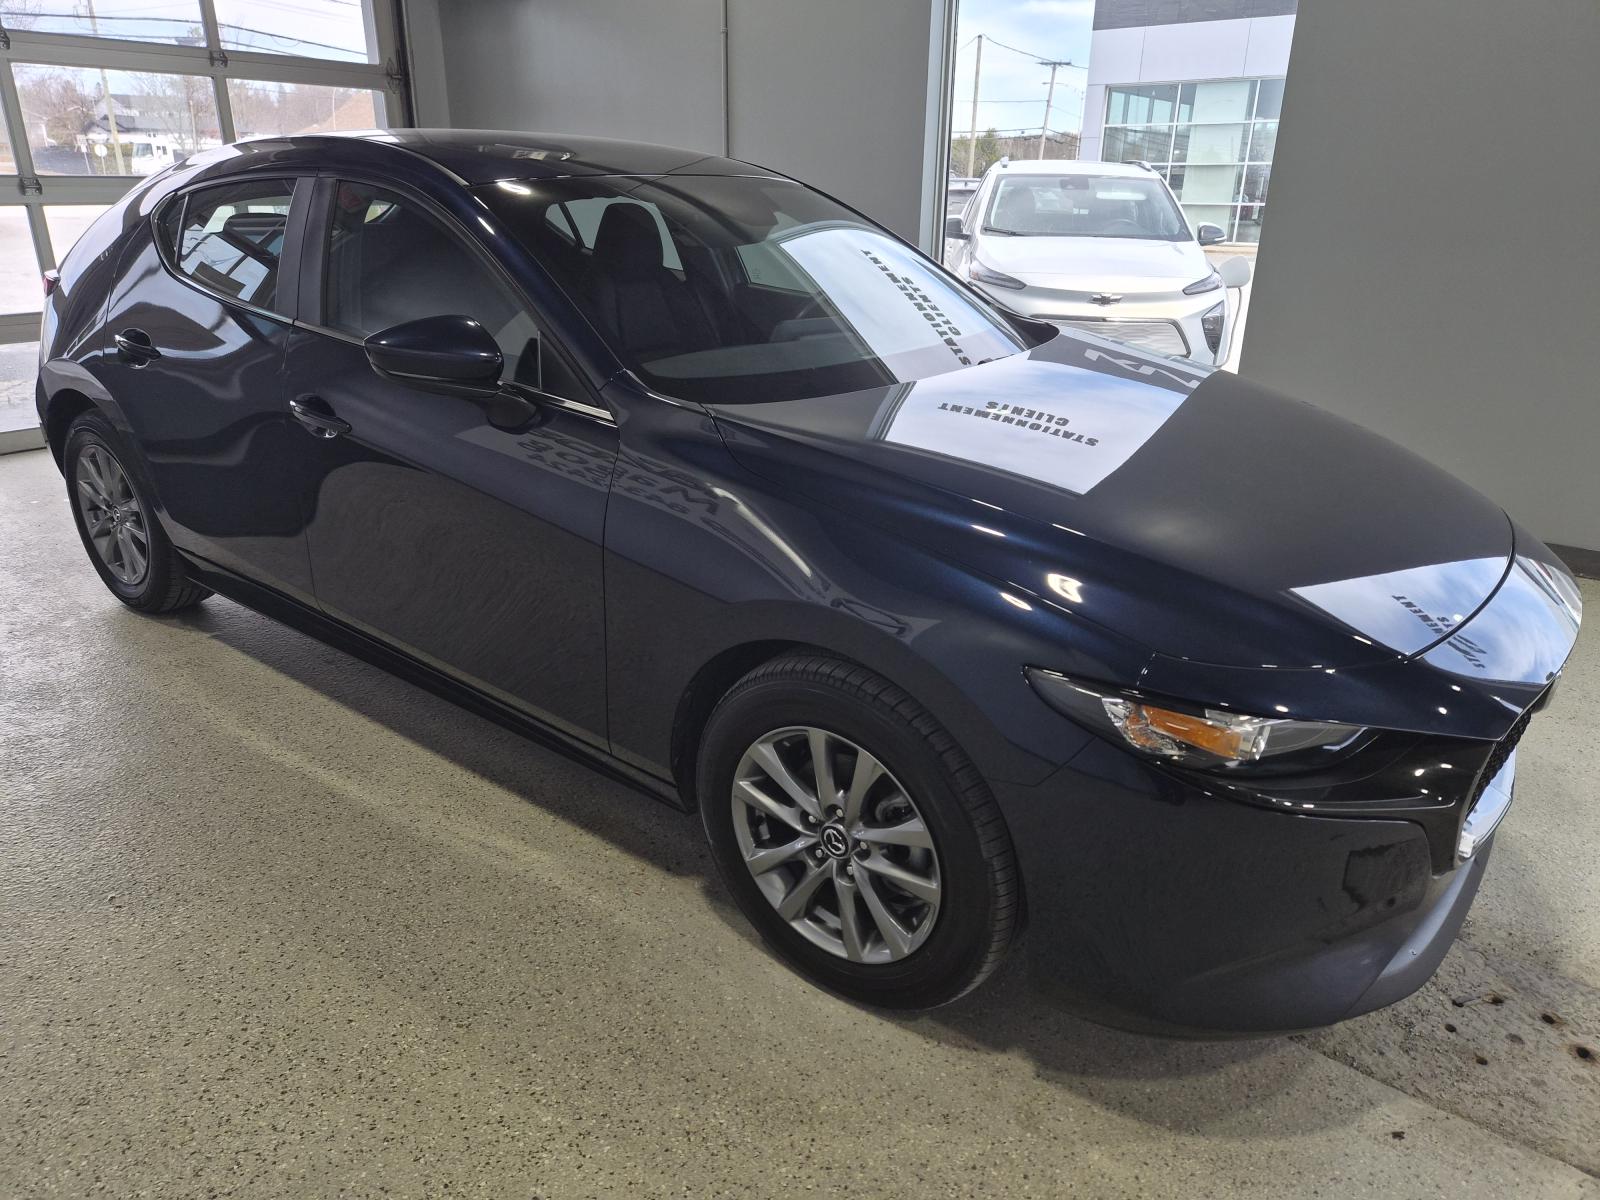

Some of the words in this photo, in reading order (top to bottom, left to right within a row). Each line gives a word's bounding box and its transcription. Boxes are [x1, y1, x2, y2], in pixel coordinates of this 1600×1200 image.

[860, 250, 972, 365] STATIONNEMENT
[901, 277, 961, 336] CLIENTS
[937, 402, 1099, 447] STATIONNEMENT
[986, 401, 1070, 426] CLIENTS
